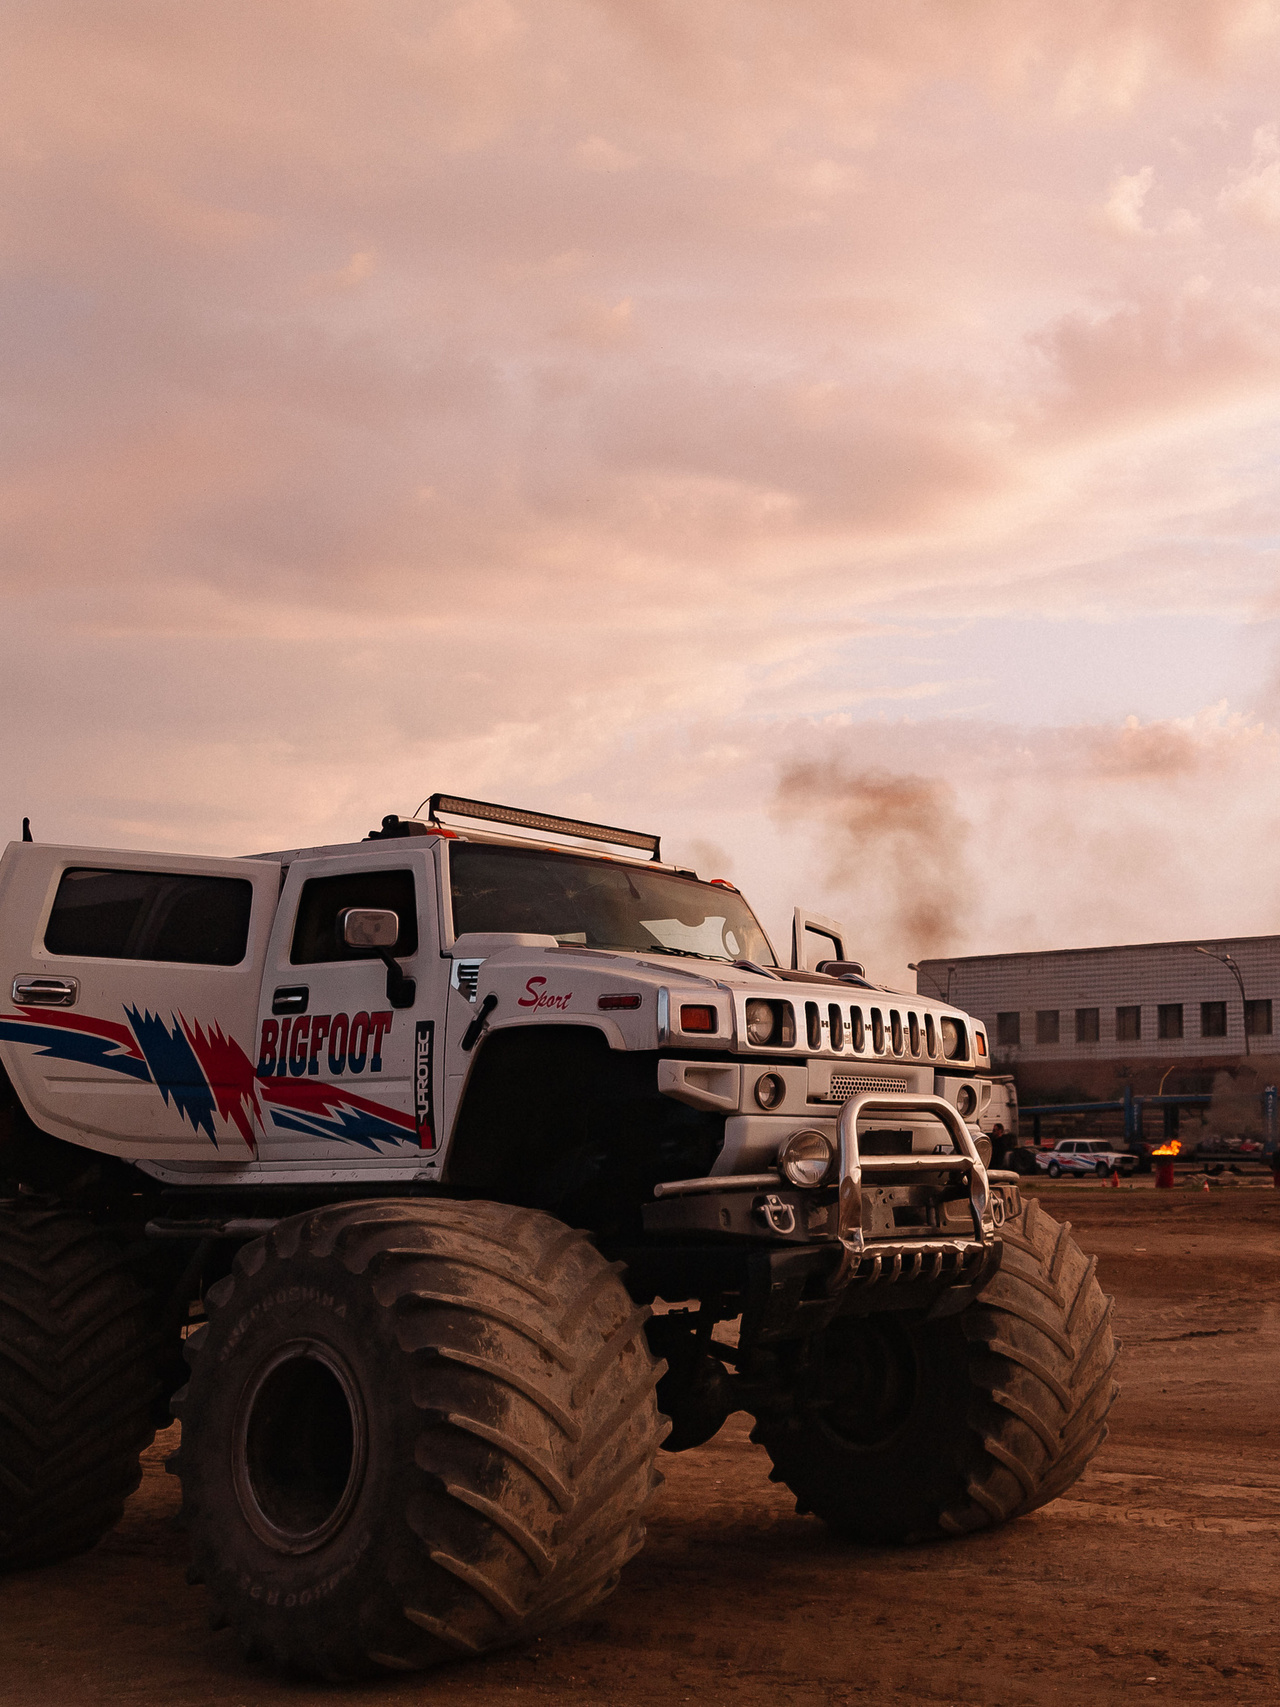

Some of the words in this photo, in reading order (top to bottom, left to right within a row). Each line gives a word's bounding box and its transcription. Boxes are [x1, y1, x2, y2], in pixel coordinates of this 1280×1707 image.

[518, 976, 573, 1013] Sport
[257, 1011, 394, 1077] BIGFOOT
[821, 1020, 926, 1037] HUMMER
